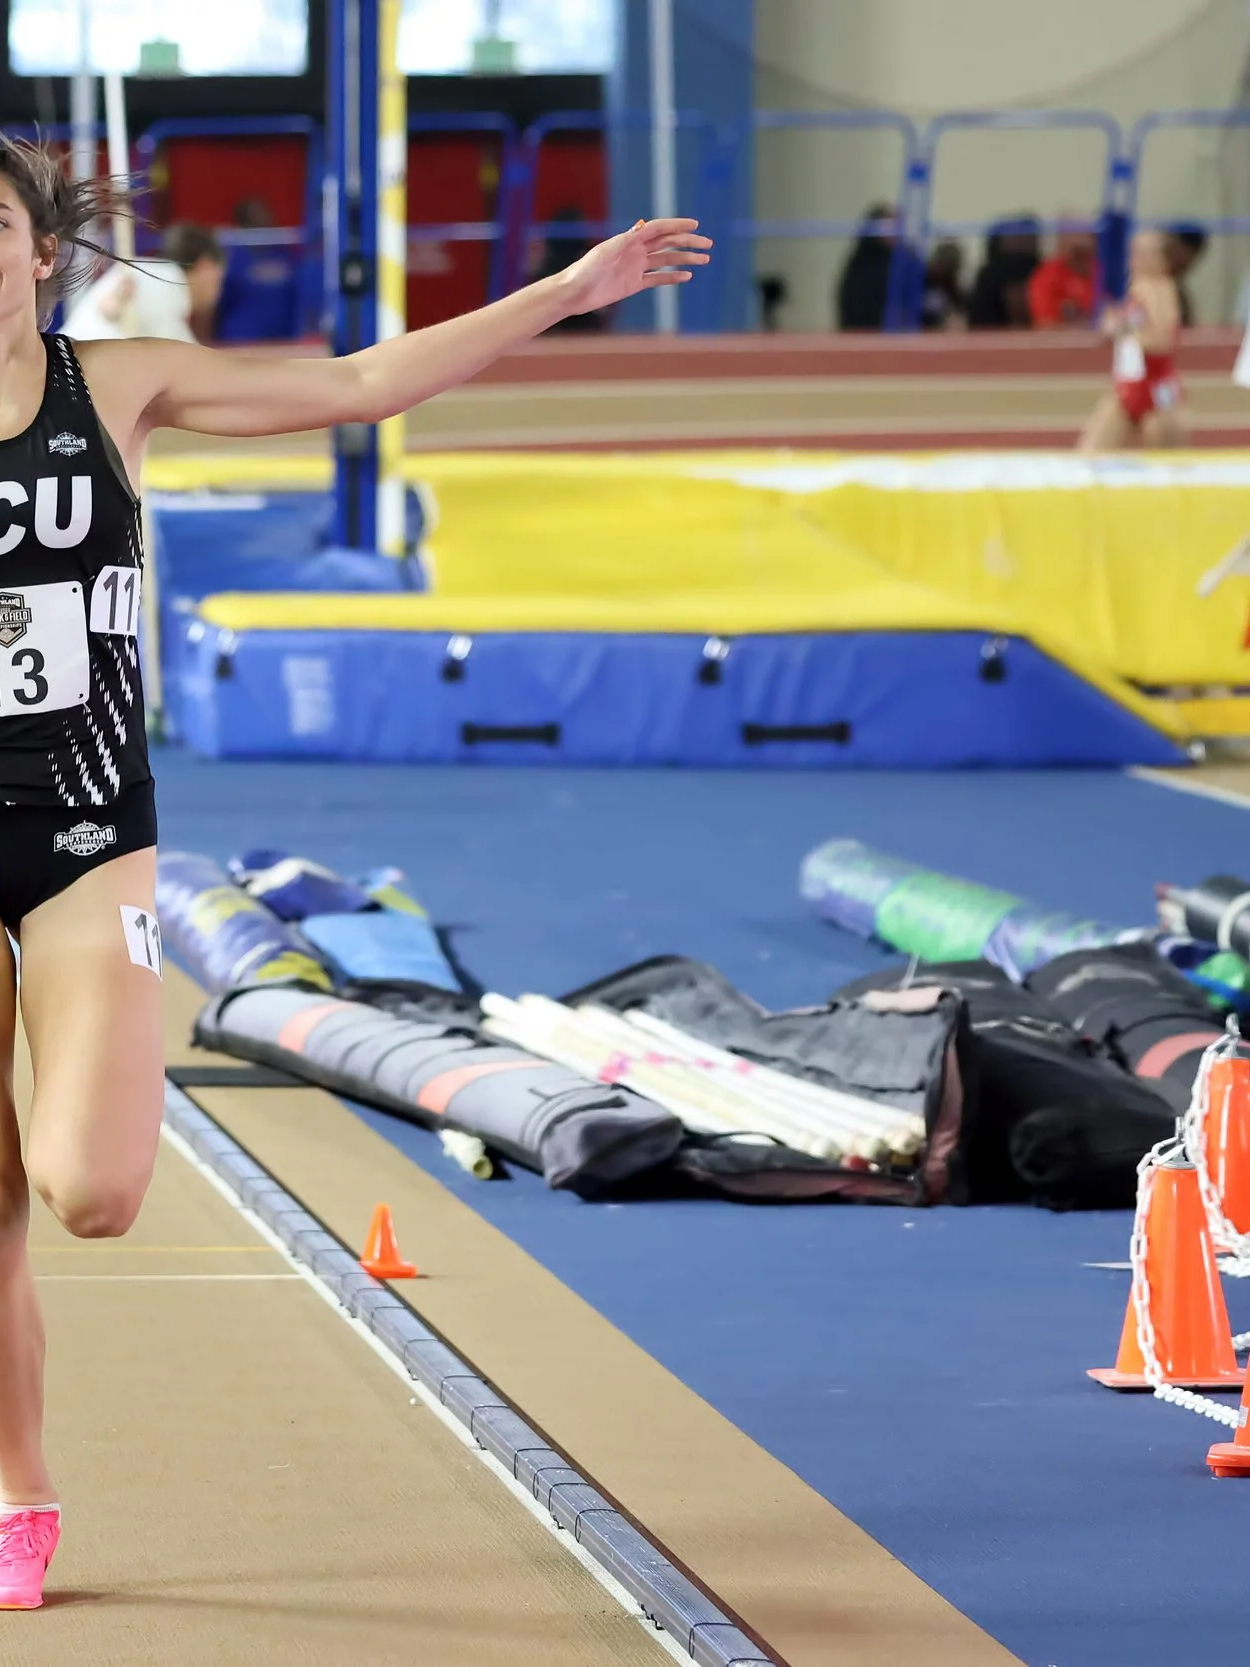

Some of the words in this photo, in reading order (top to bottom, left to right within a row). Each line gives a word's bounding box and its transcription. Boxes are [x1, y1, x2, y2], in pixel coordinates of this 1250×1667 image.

[49, 438, 87, 450] SOUTHLAND
[103, 571, 134, 631] 11
[56, 827, 114, 849] SOUTHLAND
[135, 913, 161, 978] 11
